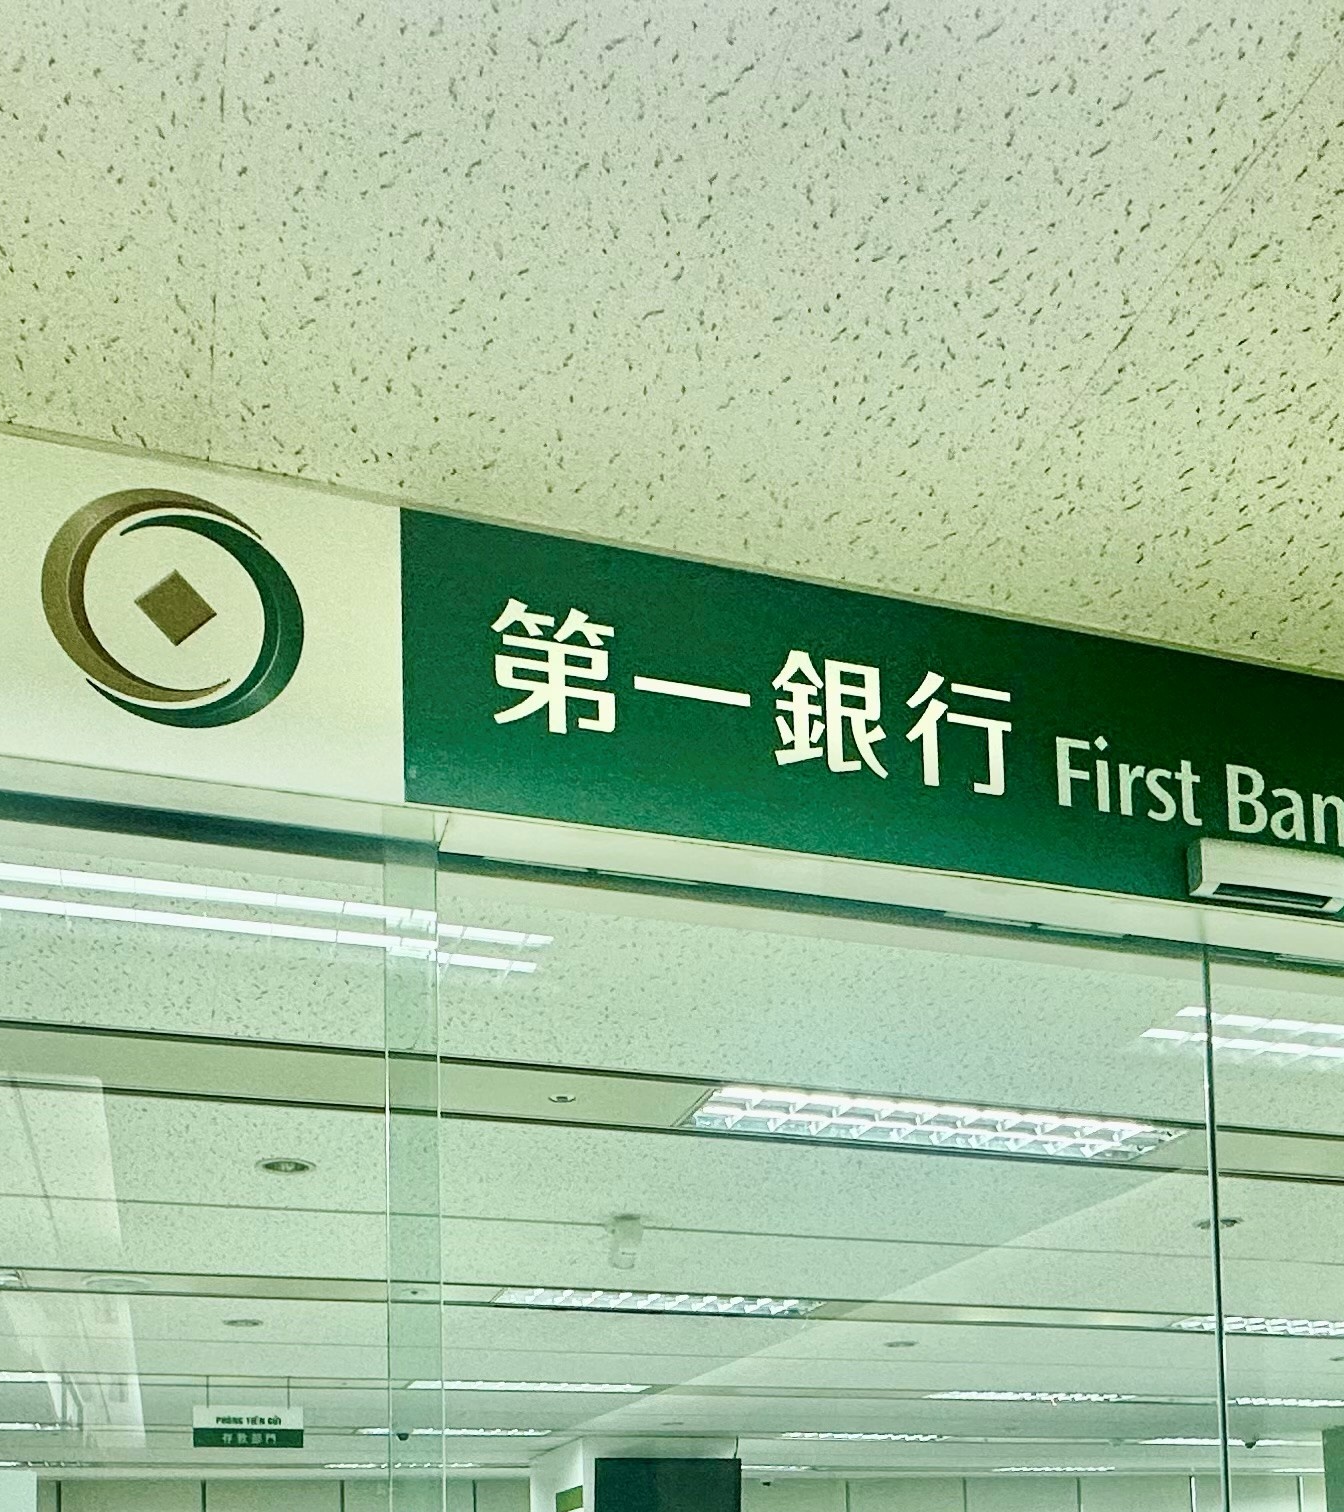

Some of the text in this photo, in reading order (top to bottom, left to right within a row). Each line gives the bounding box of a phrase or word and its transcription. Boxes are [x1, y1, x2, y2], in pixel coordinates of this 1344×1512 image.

[490, 597, 1013, 797] 第一銀行
[1056, 735, 1203, 826] First
